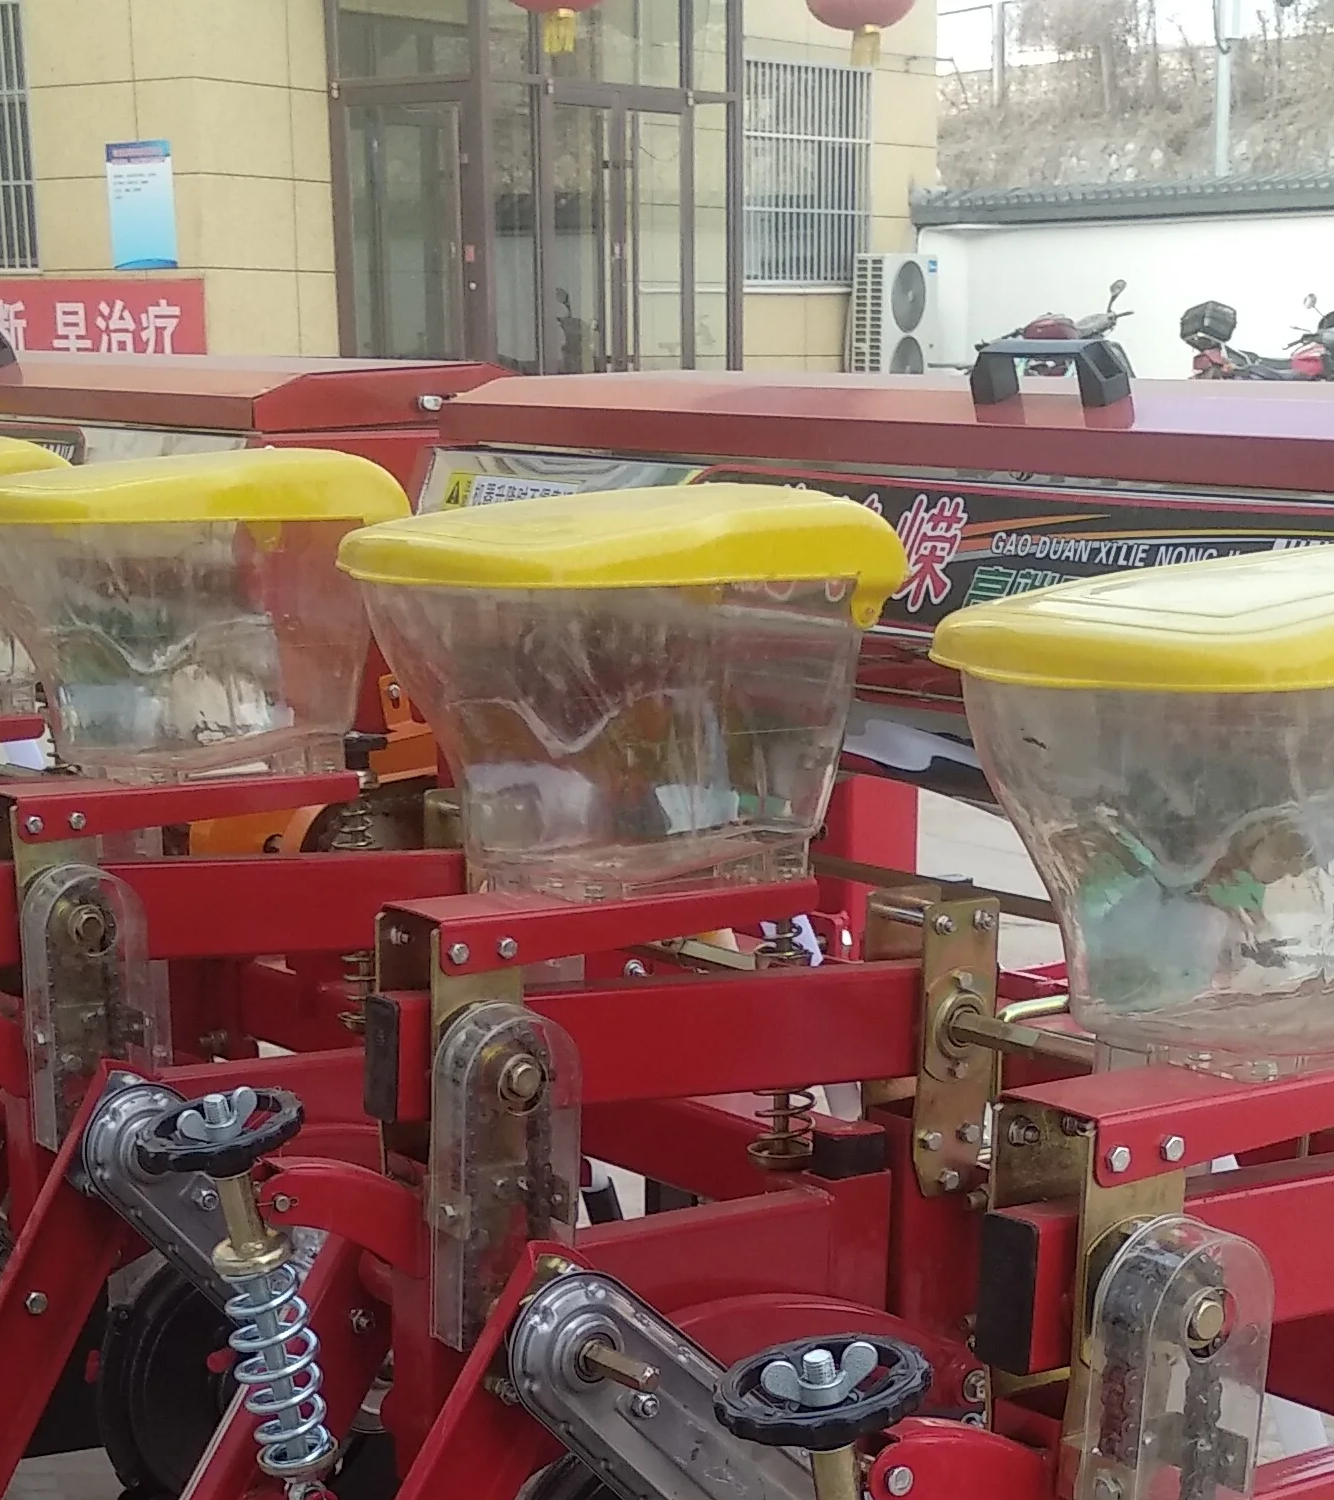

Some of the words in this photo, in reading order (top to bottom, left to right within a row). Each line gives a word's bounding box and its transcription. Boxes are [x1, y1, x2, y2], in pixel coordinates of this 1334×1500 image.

[52, 298, 182, 354] 早治疗
[991, 531, 1033, 557] GAO
[1035, 536, 1091, 563] DUAN
